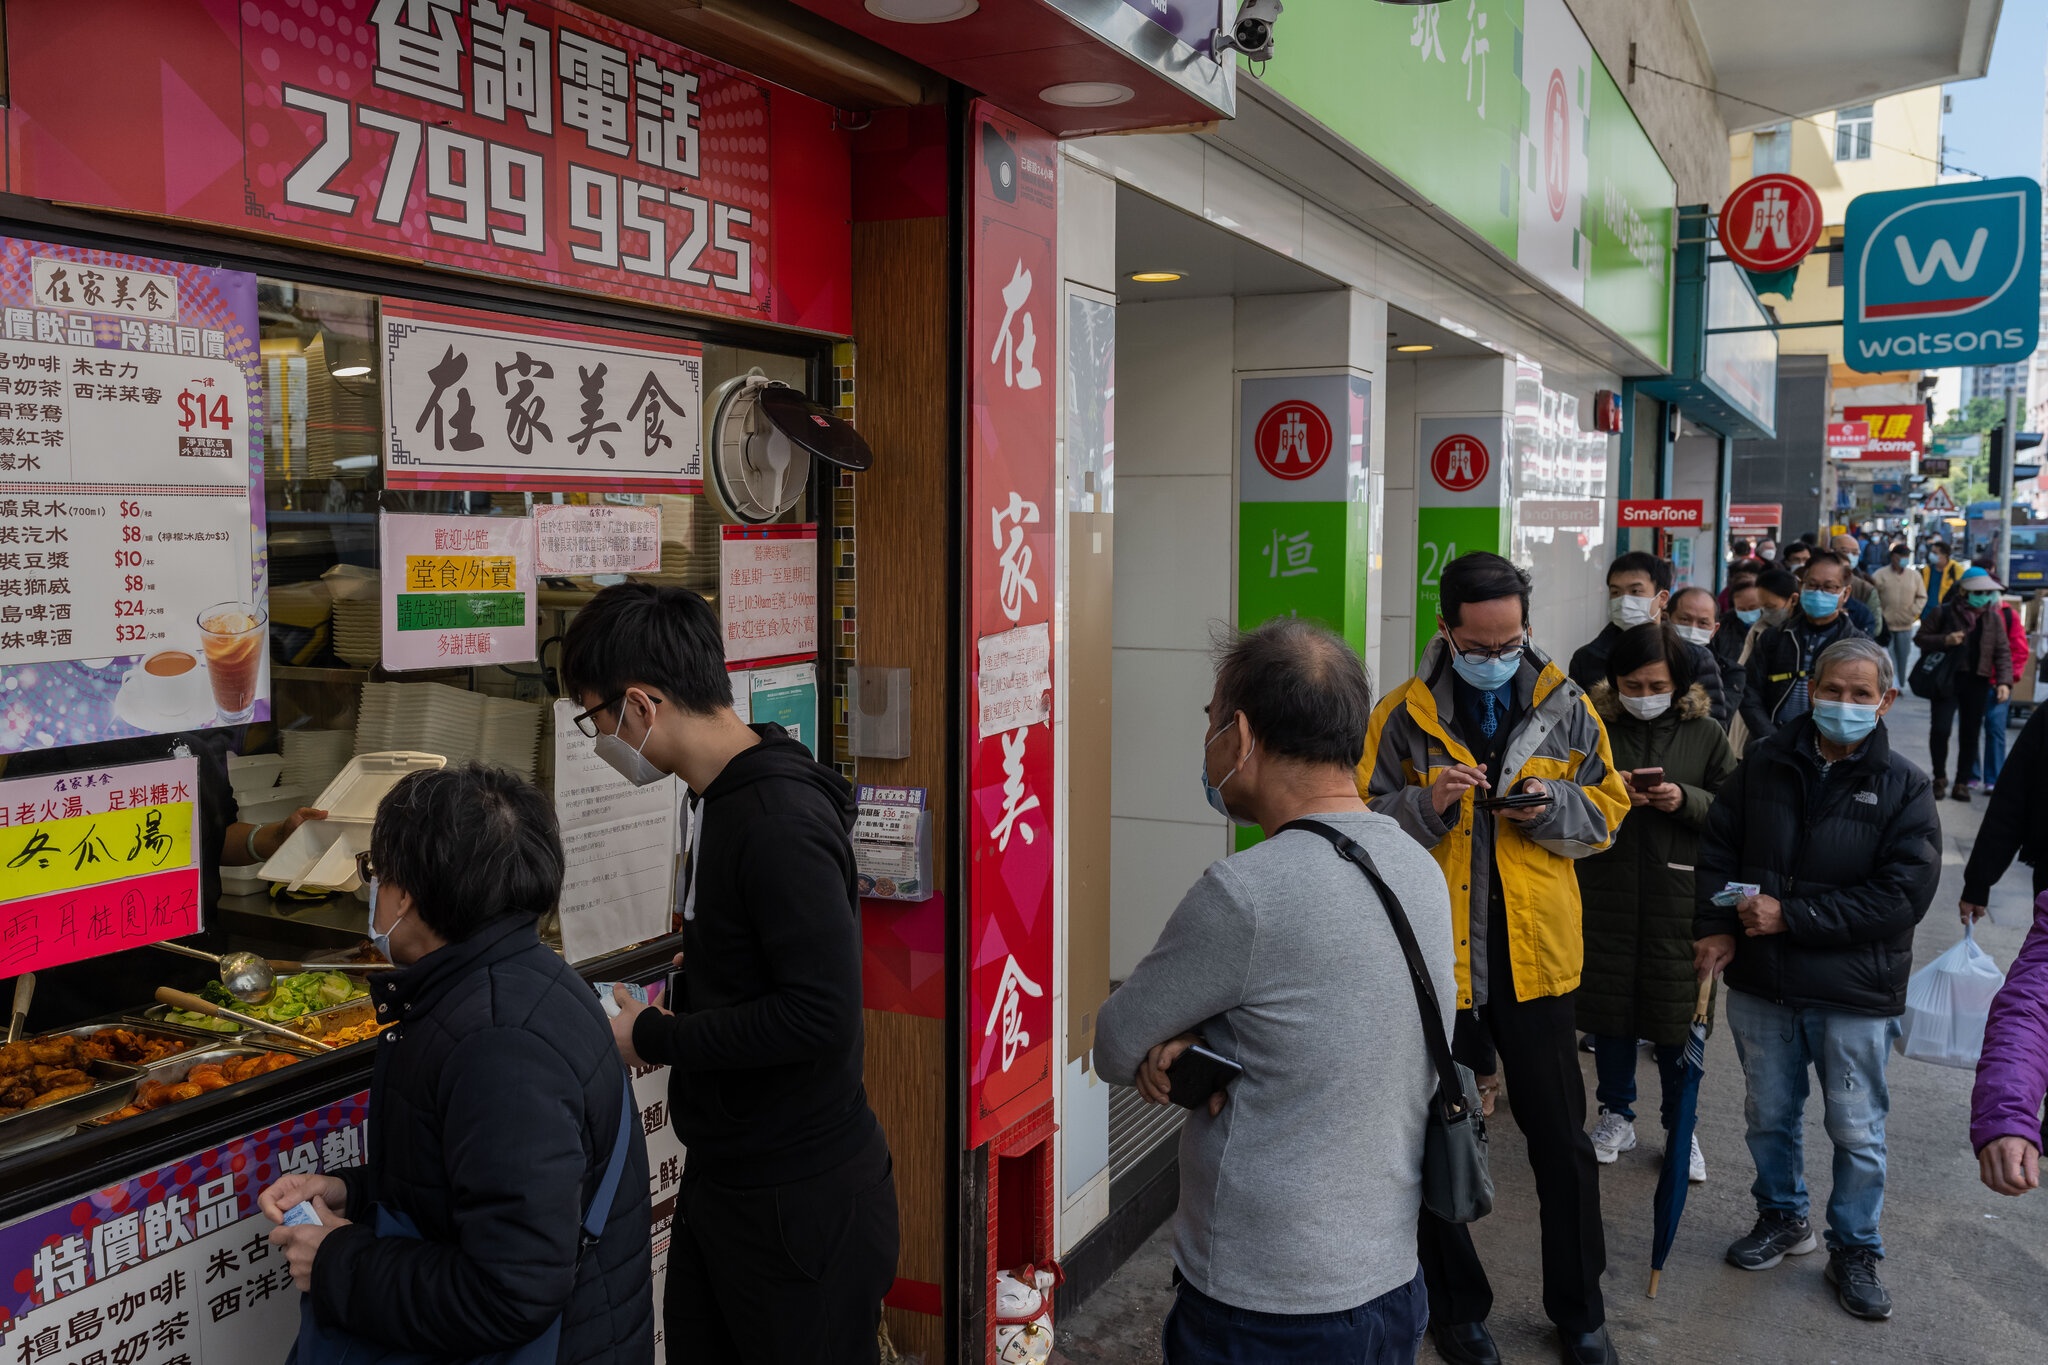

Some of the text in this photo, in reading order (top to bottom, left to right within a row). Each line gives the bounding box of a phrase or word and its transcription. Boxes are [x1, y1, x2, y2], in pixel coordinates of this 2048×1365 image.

[371, 0, 701, 180] 查詢電話
[282, 82, 753, 295] 2799 9525
[45, 266, 169, 312] 在家美食
[0, 307, 226, 360] 價飲品 冷熱同價
[1858, 327, 2025, 359] watsons
[72, 357, 138, 380] 朱古力
[191, 376, 215, 388] 一律
[73, 383, 163, 405] 西洋菜蜜
[415, 343, 687, 459] 在家美食
[177, 388, 234, 432] $14
[1623, 506, 1698, 521] SmarTone
[0, 526, 68, 544] 裝汽水
[434, 528, 489, 551] 歡迎光臨
[0, 551, 69, 571] 裝豆漿
[412, 560, 513, 589] 堂食/外賣
[0, 577, 71, 597] 裝獅威
[729, 566, 812, 587] 逢星期一至星期日
[398, 599, 457, 628] 請先說明
[727, 615, 816, 641] 歡迎堂食及外賣
[437, 632, 492, 658] 多謝惠顧
[53, 774, 114, 792] 在家美食
[6, 808, 174, 871] 冬瓜湯
[33, 1118, 368, 1304] 特價飲品 冷熱
[205, 1232, 284, 1284] 朱古
[16, 1269, 187, 1365] 檀島咖啡
